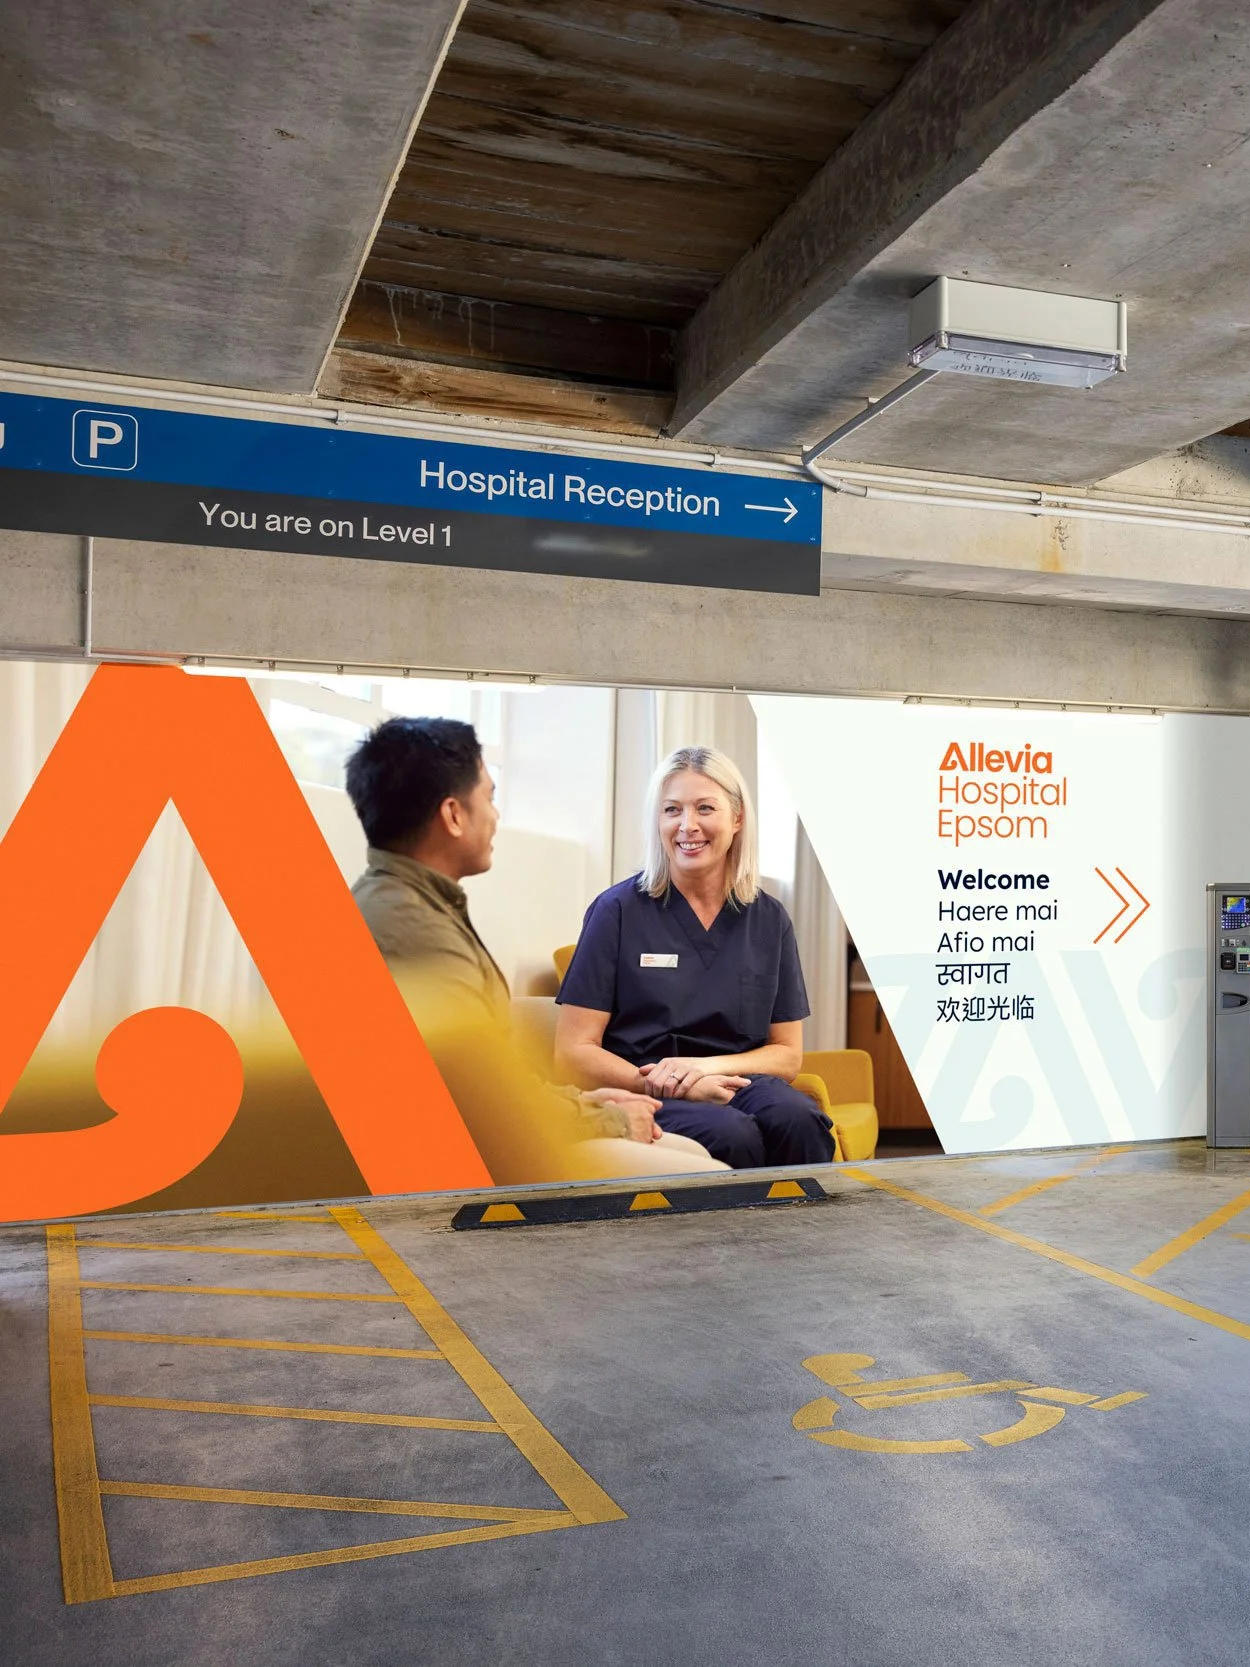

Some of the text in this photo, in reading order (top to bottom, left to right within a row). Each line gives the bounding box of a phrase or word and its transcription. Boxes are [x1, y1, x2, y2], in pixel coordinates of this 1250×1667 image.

[89, 419, 124, 459] P
[419, 459, 721, 518] Hospital Reception
[198, 501, 453, 547] You are on Level 1
[939, 742, 1053, 774] Allevia
[938, 775, 1067, 813] Hospital
[938, 809, 1048, 847] Epsom
[938, 869, 1050, 890] Welcome
[938, 900, 1058, 922] Haere mai
[937, 931, 1035, 953] Afio mai
[935, 962, 1010, 985] स्वागत
[936, 994, 1035, 1022] 欢迎光临
